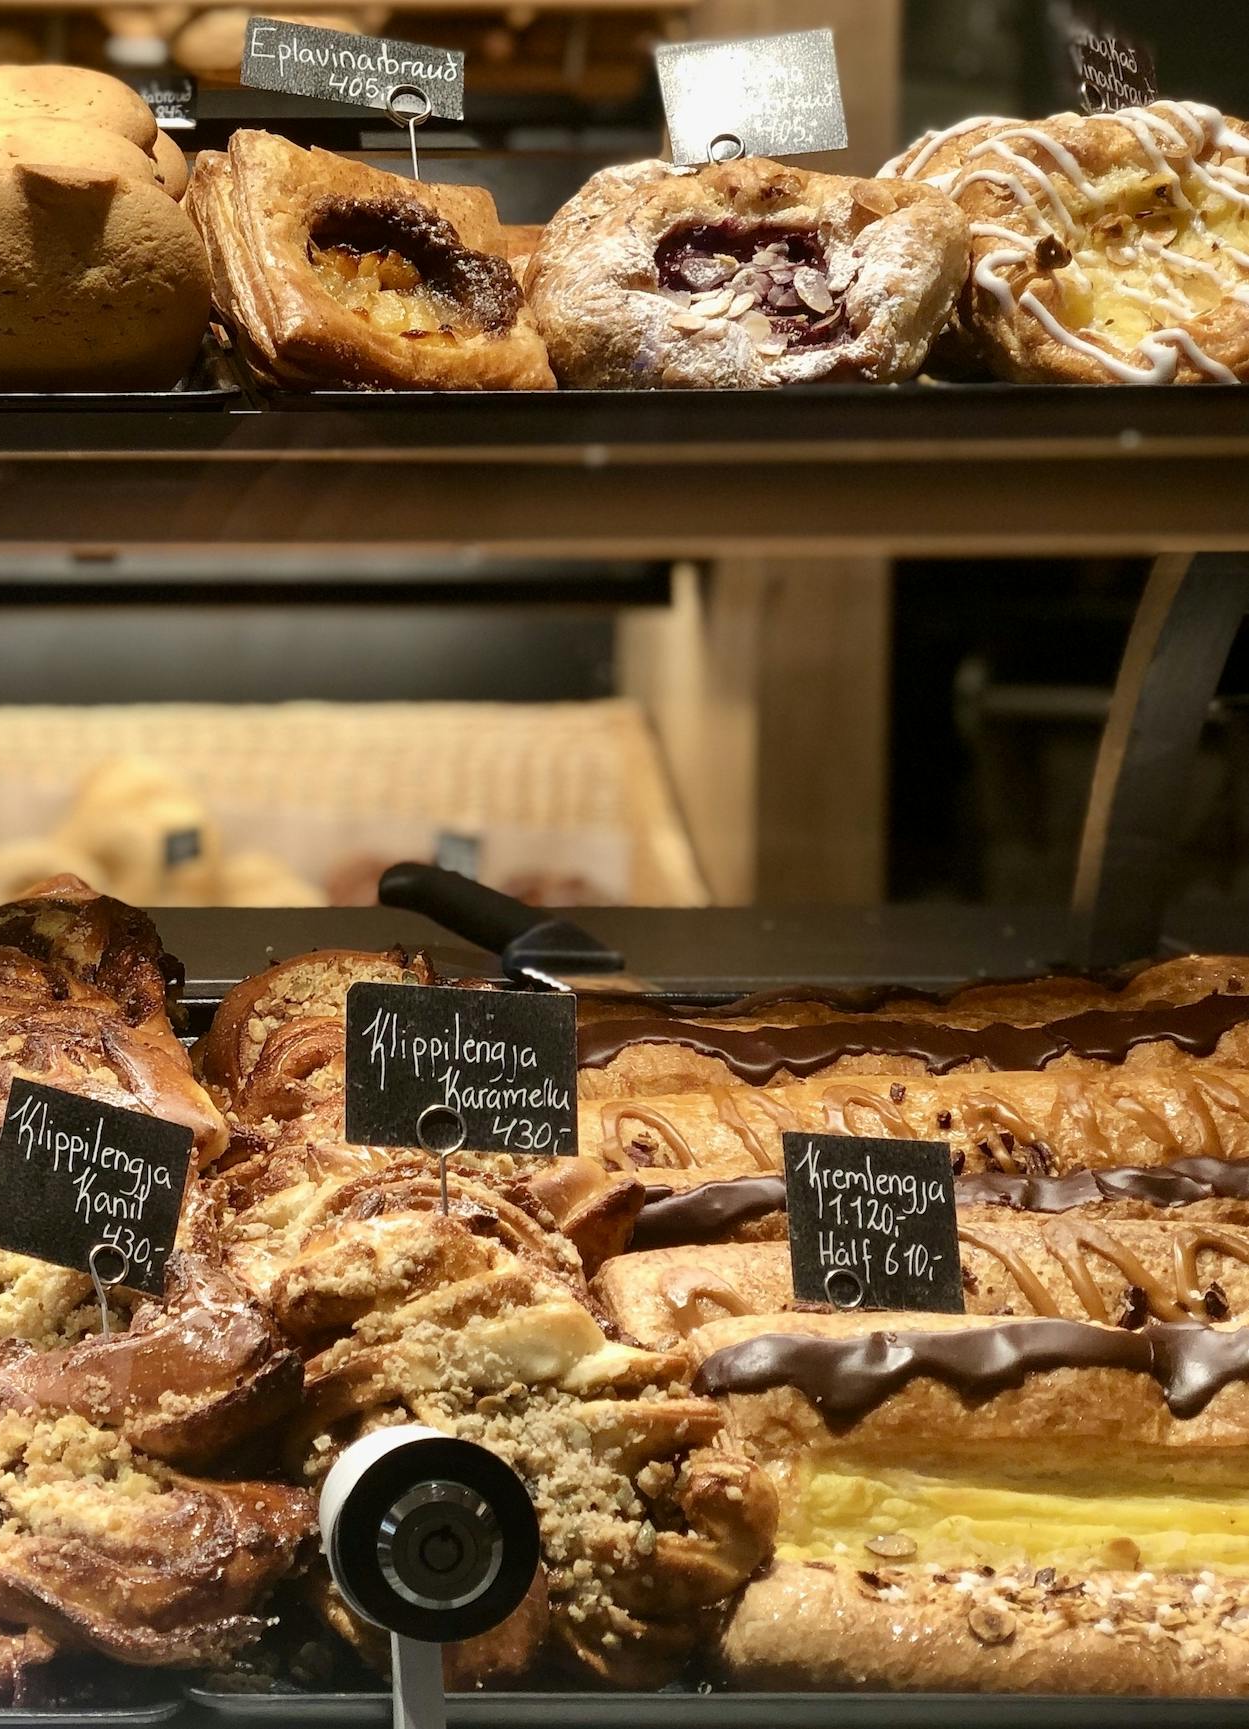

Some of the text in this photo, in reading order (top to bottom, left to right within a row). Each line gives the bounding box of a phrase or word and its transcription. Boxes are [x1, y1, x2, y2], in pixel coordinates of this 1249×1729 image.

[361, 1007, 538, 1092] Klippilengja
[437, 1065, 571, 1113] Karamellu
[8, 1095, 172, 1201] Klippilengja
[492, 1116, 572, 1156] 430,-
[794, 1141, 946, 1220] Kremlengja
